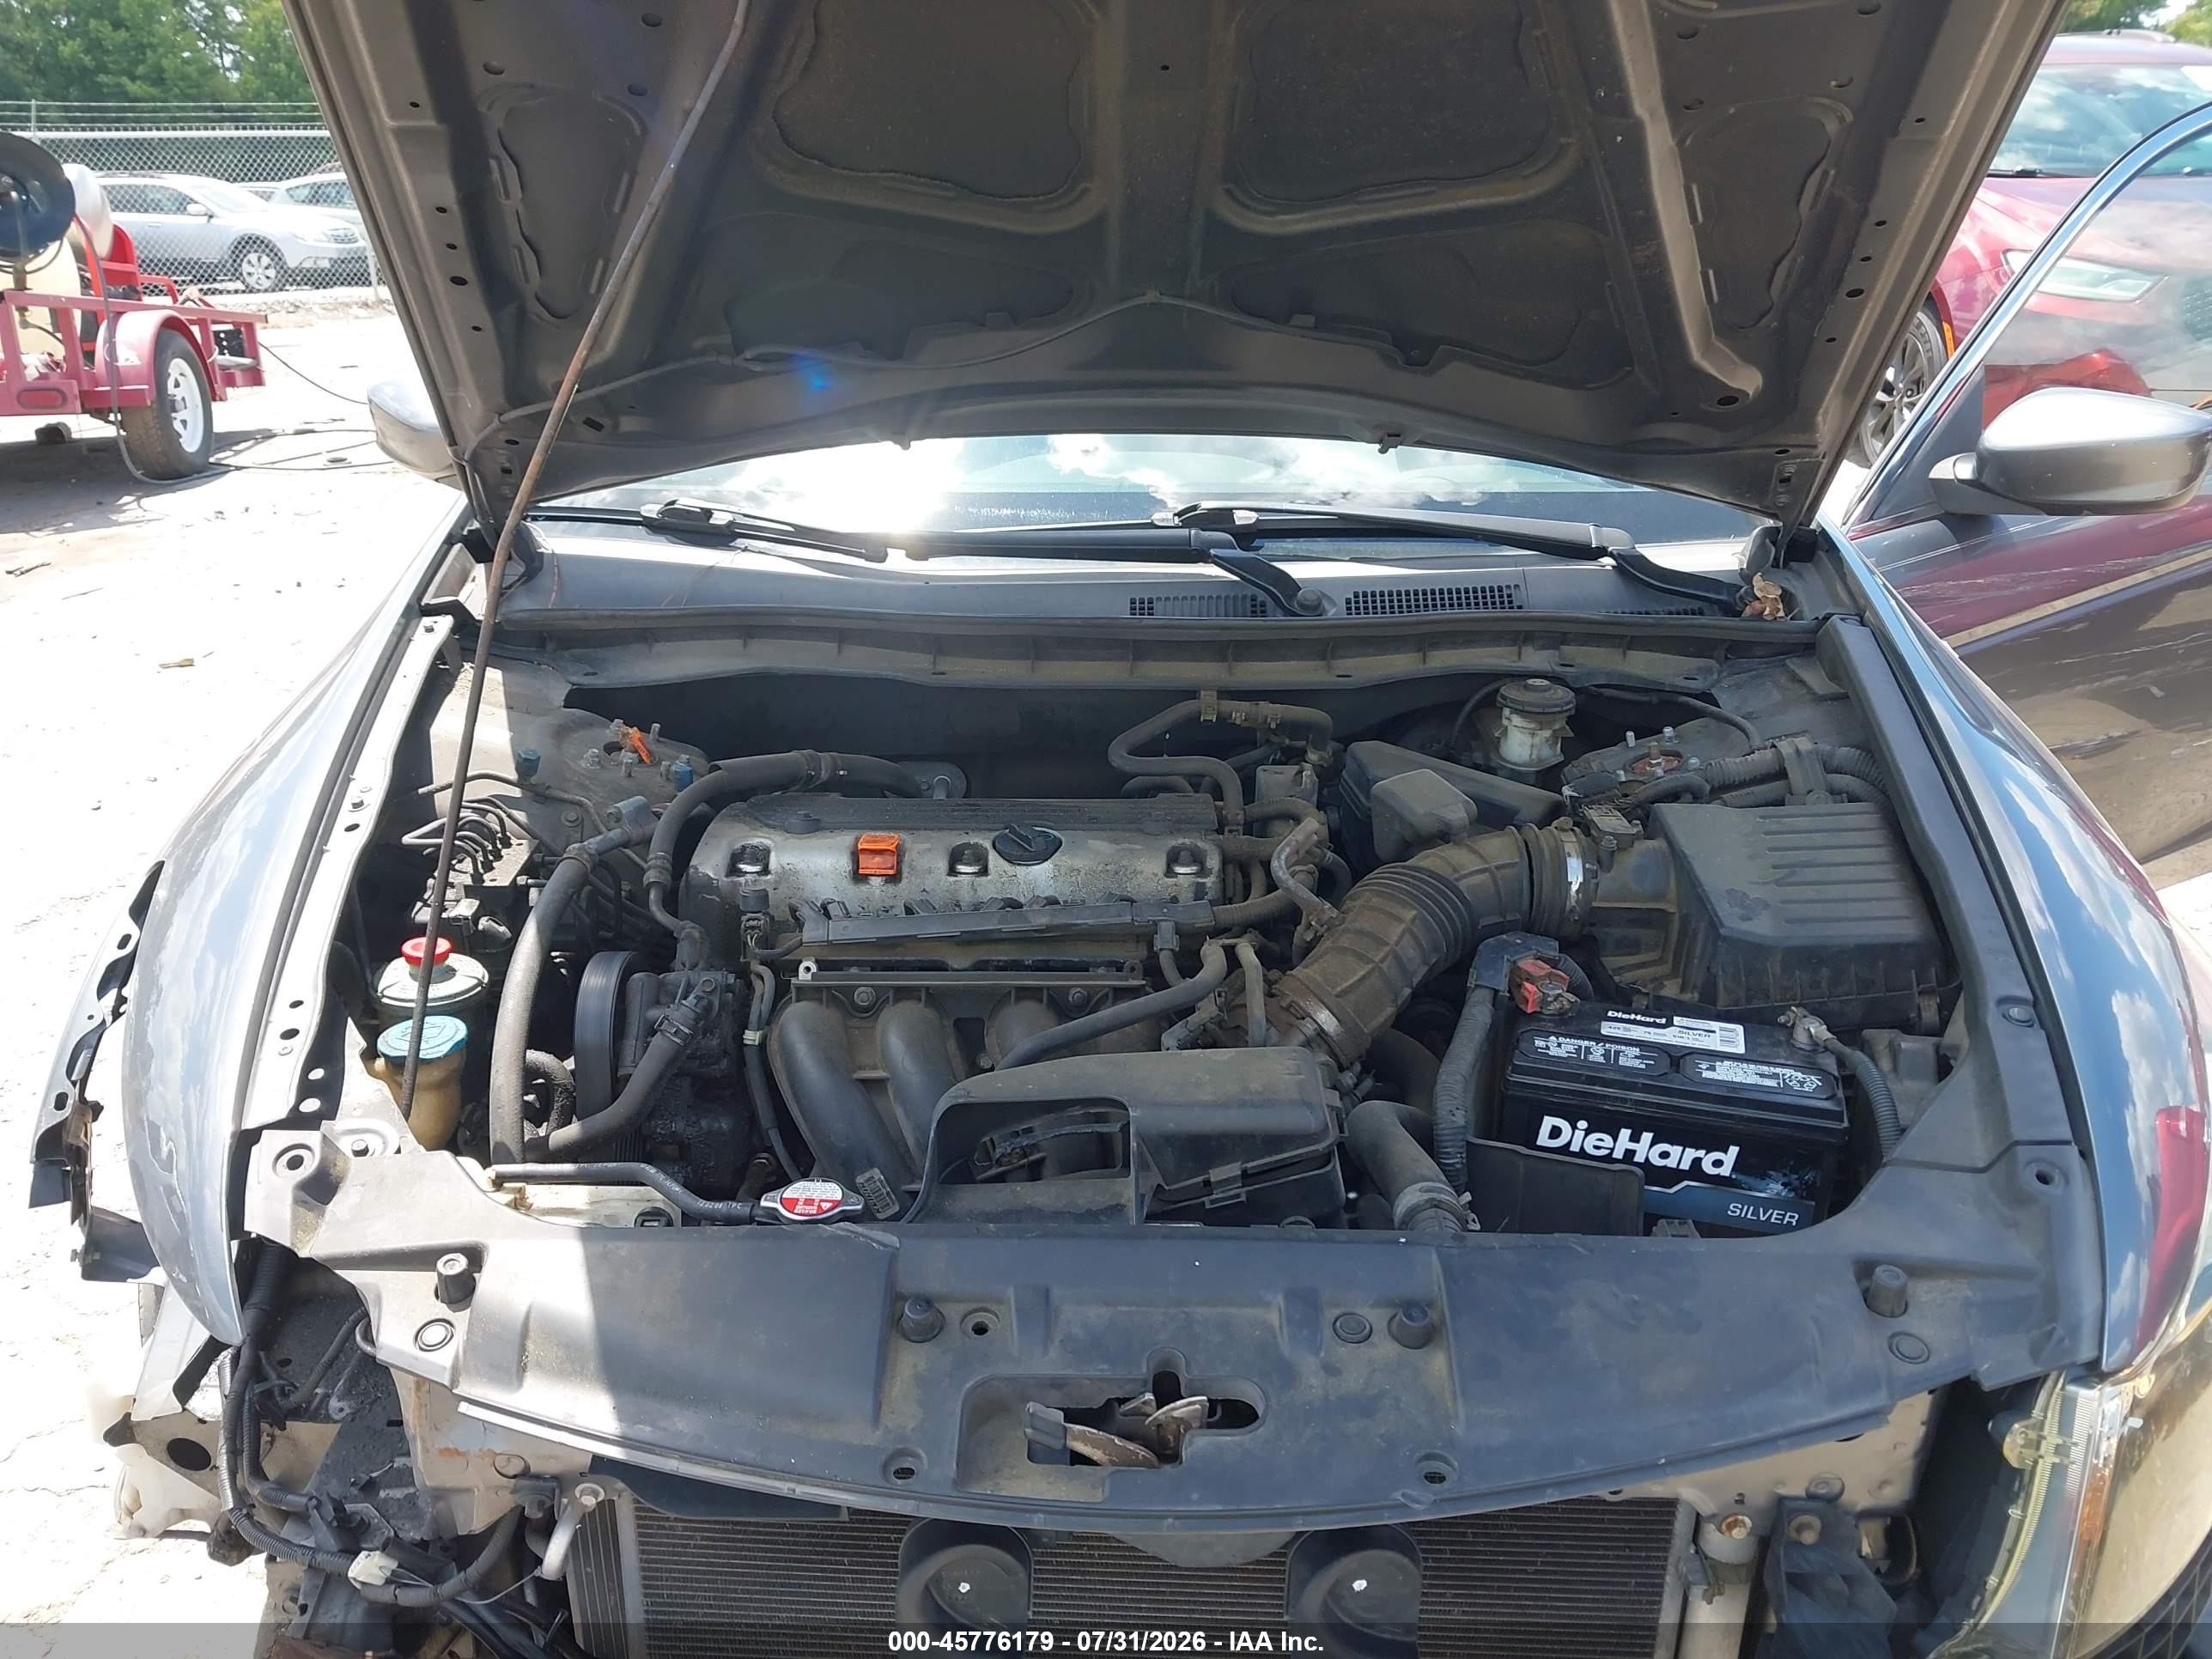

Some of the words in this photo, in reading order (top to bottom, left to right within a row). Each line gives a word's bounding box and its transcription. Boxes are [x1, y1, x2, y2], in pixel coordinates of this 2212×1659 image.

[1607, 1010, 1667, 1024] DieHard
[1677, 1030, 1711, 1038] SILVER
[1558, 1036, 1596, 1047] DANGER
[1605, 1043, 1640, 1052] POISON
[1536, 1115, 1740, 1177] DieHard
[1728, 1203, 1799, 1226] SILVER
